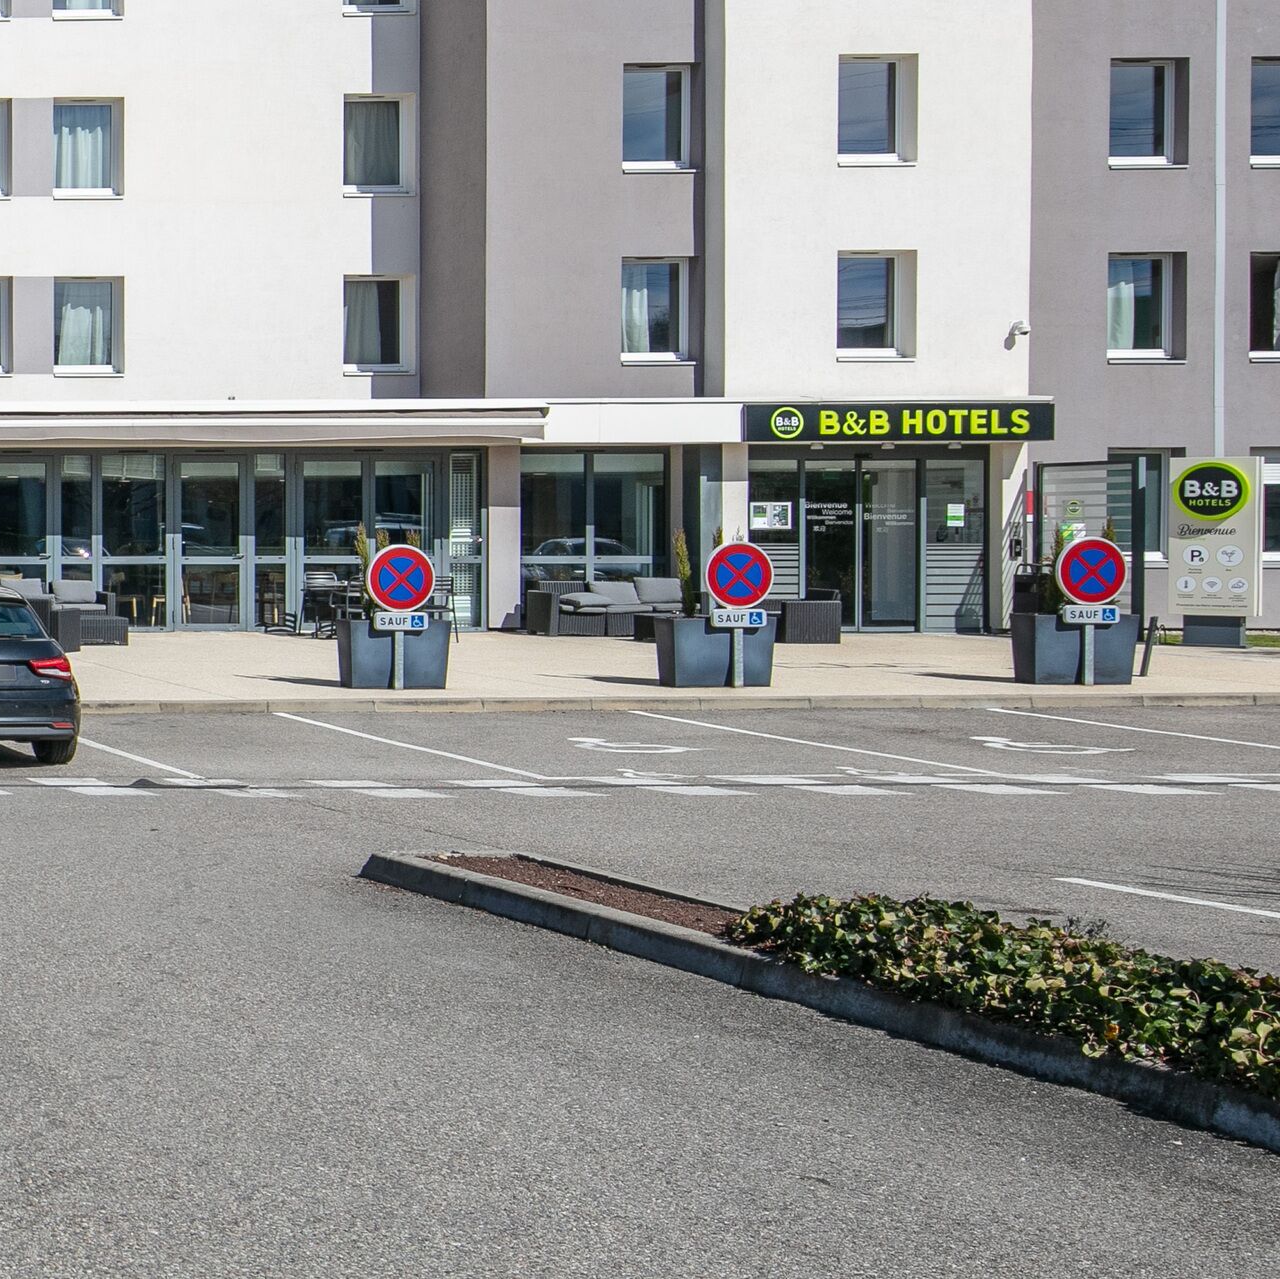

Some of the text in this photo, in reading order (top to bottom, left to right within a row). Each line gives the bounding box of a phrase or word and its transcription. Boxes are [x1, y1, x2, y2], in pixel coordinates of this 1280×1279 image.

[775, 416, 799, 426] B&B
[820, 409, 1030, 435] B&B HOTELS
[1183, 480, 1238, 498] B&B
[805, 501, 848, 509] Bienvenue
[1188, 499, 1232, 507] HOTELS
[863, 512, 908, 520] Bienvenue
[1177, 523, 1237, 536] Bienvenue
[717, 614, 746, 623] SAUF
[1070, 610, 1099, 619] SAUF
[380, 617, 408, 626] SAUF
